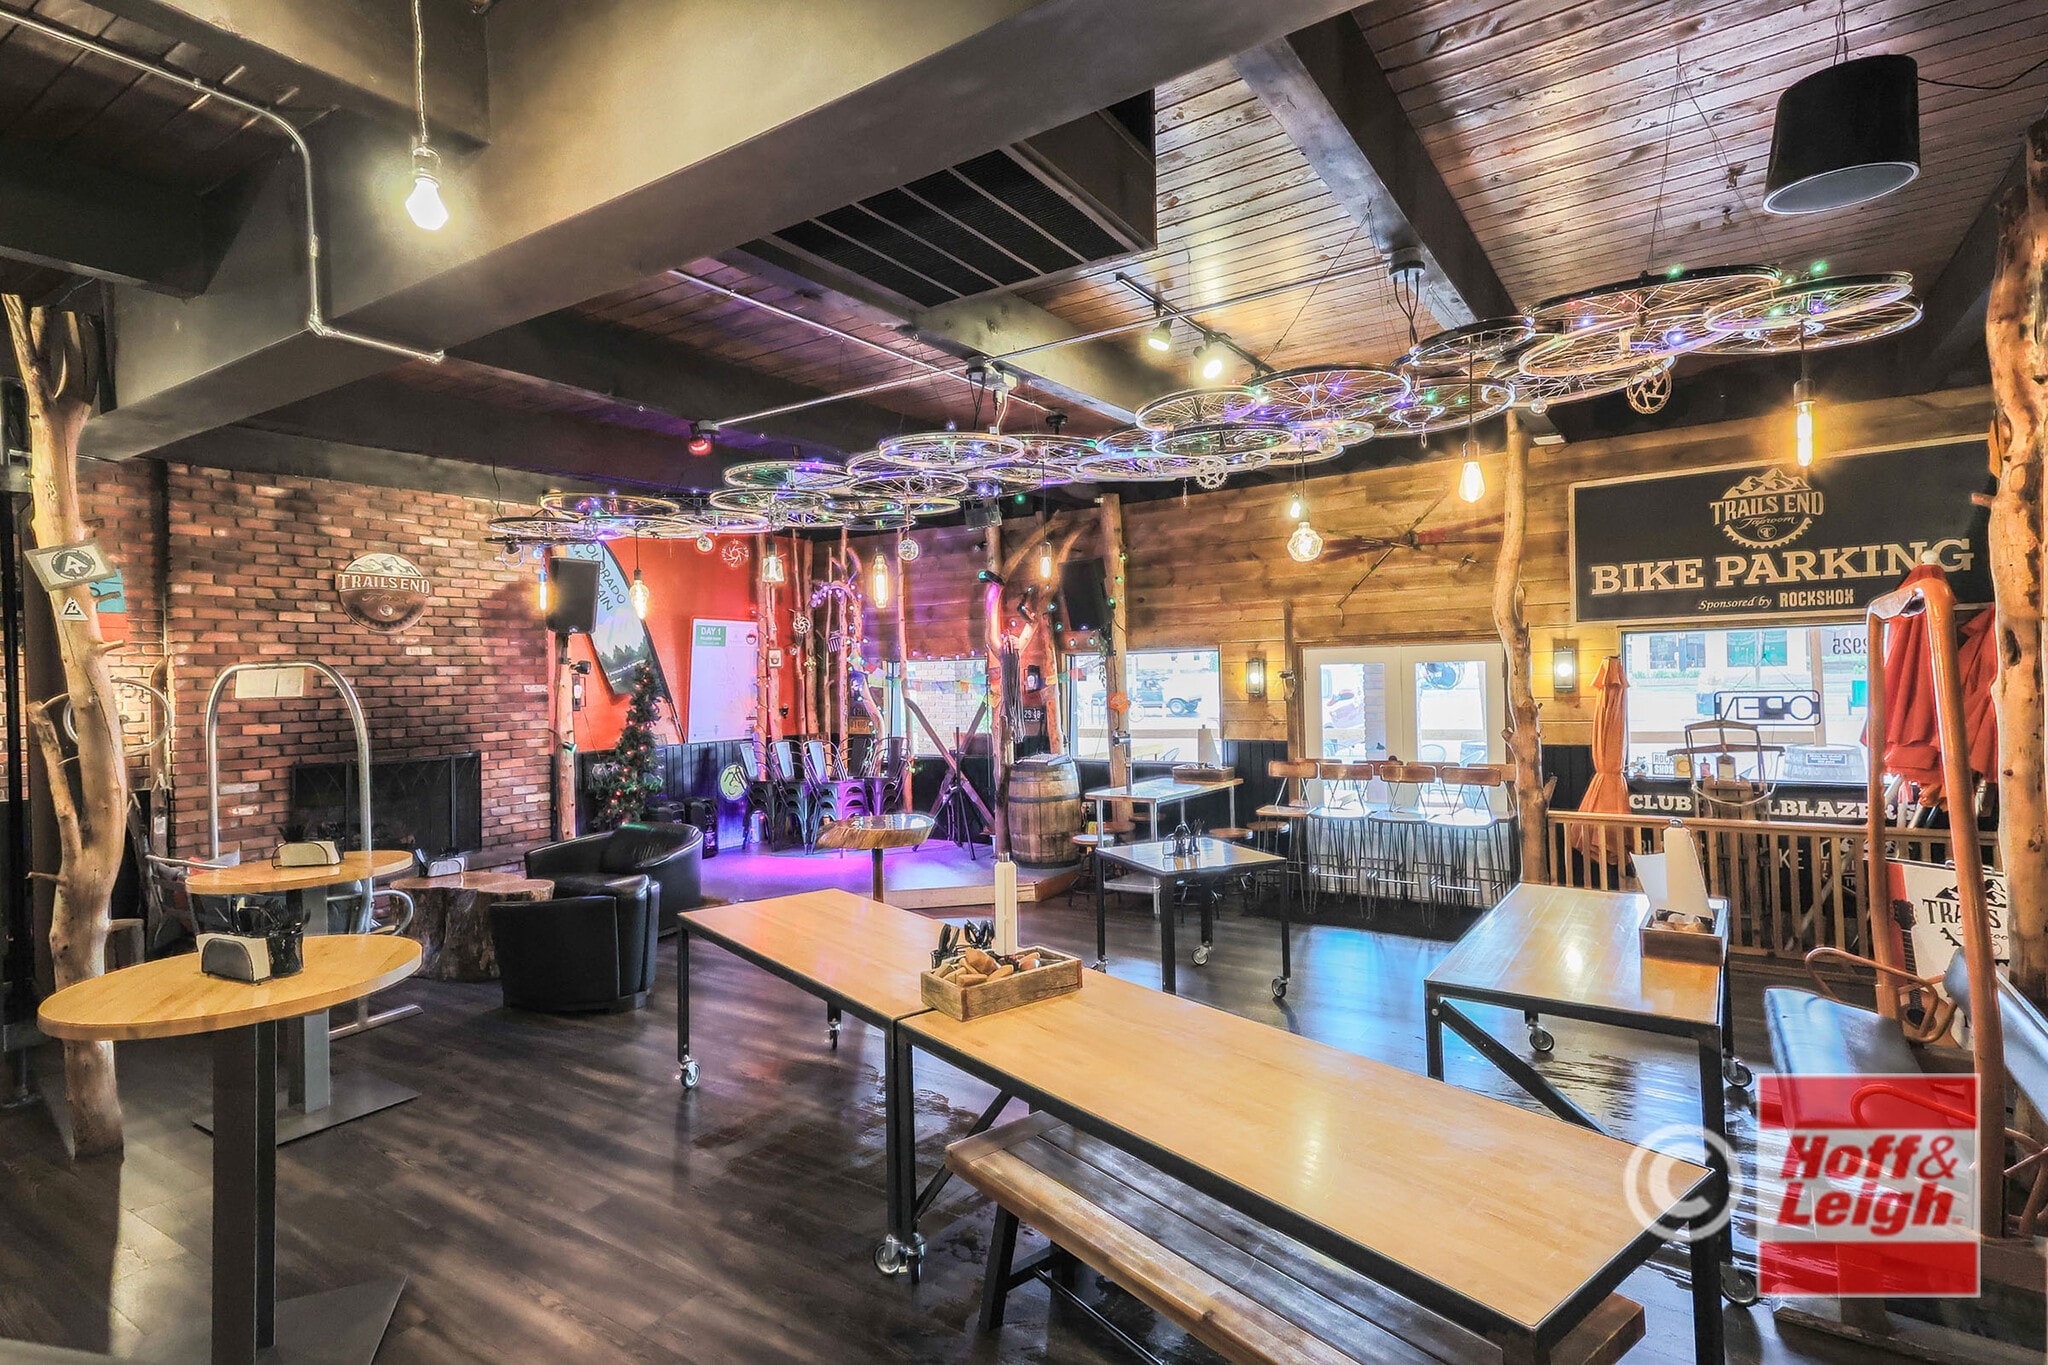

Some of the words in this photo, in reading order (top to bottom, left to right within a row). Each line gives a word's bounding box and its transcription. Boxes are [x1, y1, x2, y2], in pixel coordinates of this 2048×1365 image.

[1709, 495, 1779, 525] TRAILS
[1784, 491, 1825, 516] END
[1591, 558, 1705, 595] BIKE
[1715, 538, 1975, 587] PARKING
[1698, 599, 1755, 612] Sponsored
[1758, 596, 1772, 609] by
[1779, 588, 1854, 608] ROCKSHOX
[701, 626, 716, 636] DAY
[717, 627, 721, 636] 1
[1628, 794, 1692, 811] CLUB
